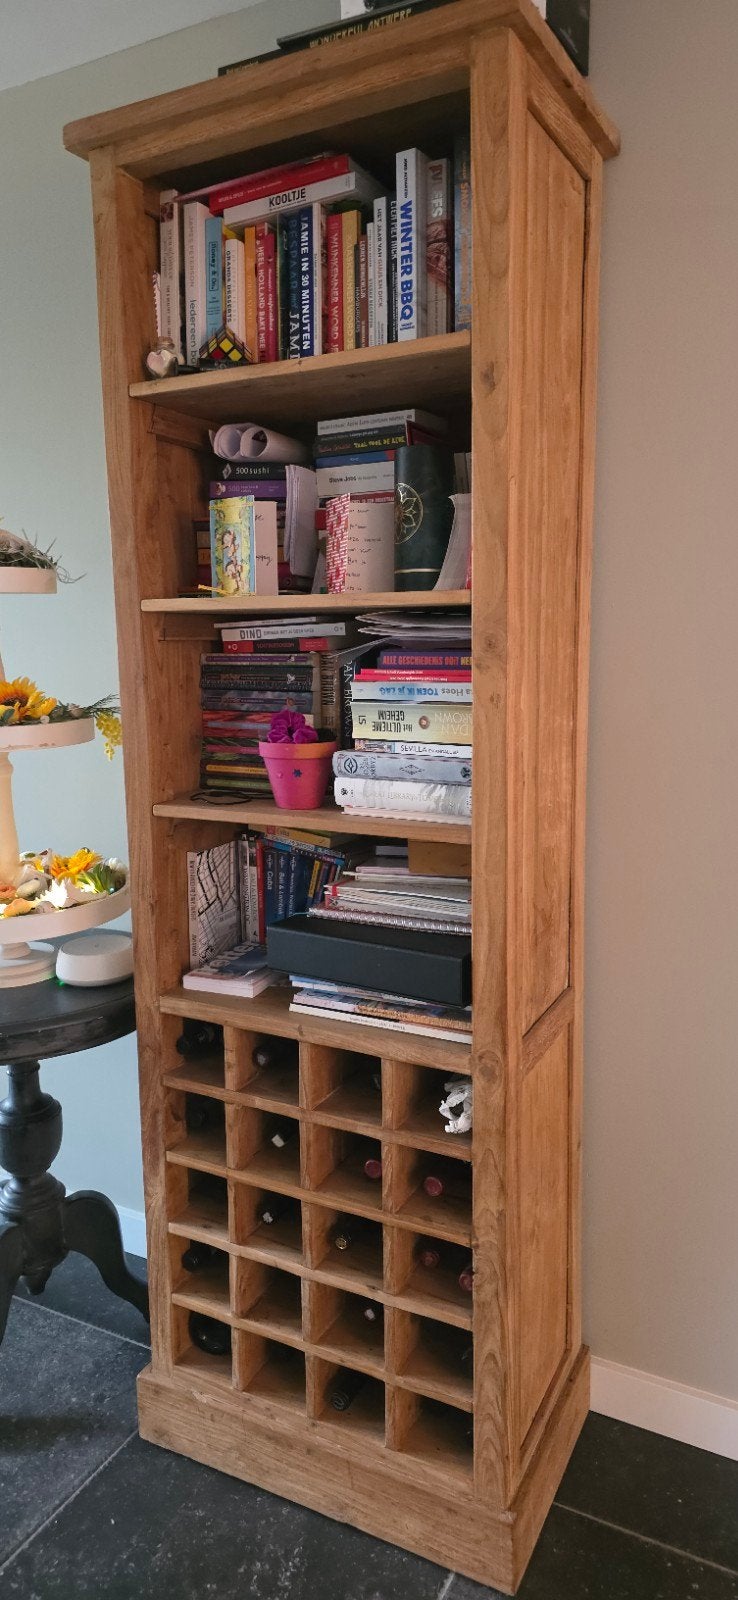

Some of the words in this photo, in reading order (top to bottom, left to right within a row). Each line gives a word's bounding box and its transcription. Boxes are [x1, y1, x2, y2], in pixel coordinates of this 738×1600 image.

[268, 188, 306, 208] KOOLTJE
[188, 216, 196, 241] JAMES
[300, 215, 309, 255] JAMIE
[400, 200, 413, 279] WINTER
[257, 246, 265, 266] HEEL
[288, 219, 299, 289] BESPAAR
[301, 257, 309, 272] IN
[329, 233, 339, 304] WIJNKENNER
[258, 269, 266, 309] HOLLAND
[301, 274, 310, 287] 30
[400, 279, 414, 321] BBQ
[189, 299, 199, 347] Iedereen
[301, 289, 311, 351] MINUTEN
[329, 305, 339, 340] WORD
[346, 304, 354, 336] WORD
[235, 466, 248, 475] 500
[248, 466, 271, 475] sushi
[239, 629, 262, 640] DINO
[382, 655, 397, 665] ALLE
[398, 656, 442, 666] GESCHIEDENIS
[407, 687, 416, 696] IK
[416, 687, 439, 696] TOEN
[441, 687, 464, 697] Hoes
[377, 710, 405, 721] GEHEIM
[371, 721, 402, 733] ULTIEME
[441, 725, 469, 736] DAN
[266, 870, 274, 890] Cuba
